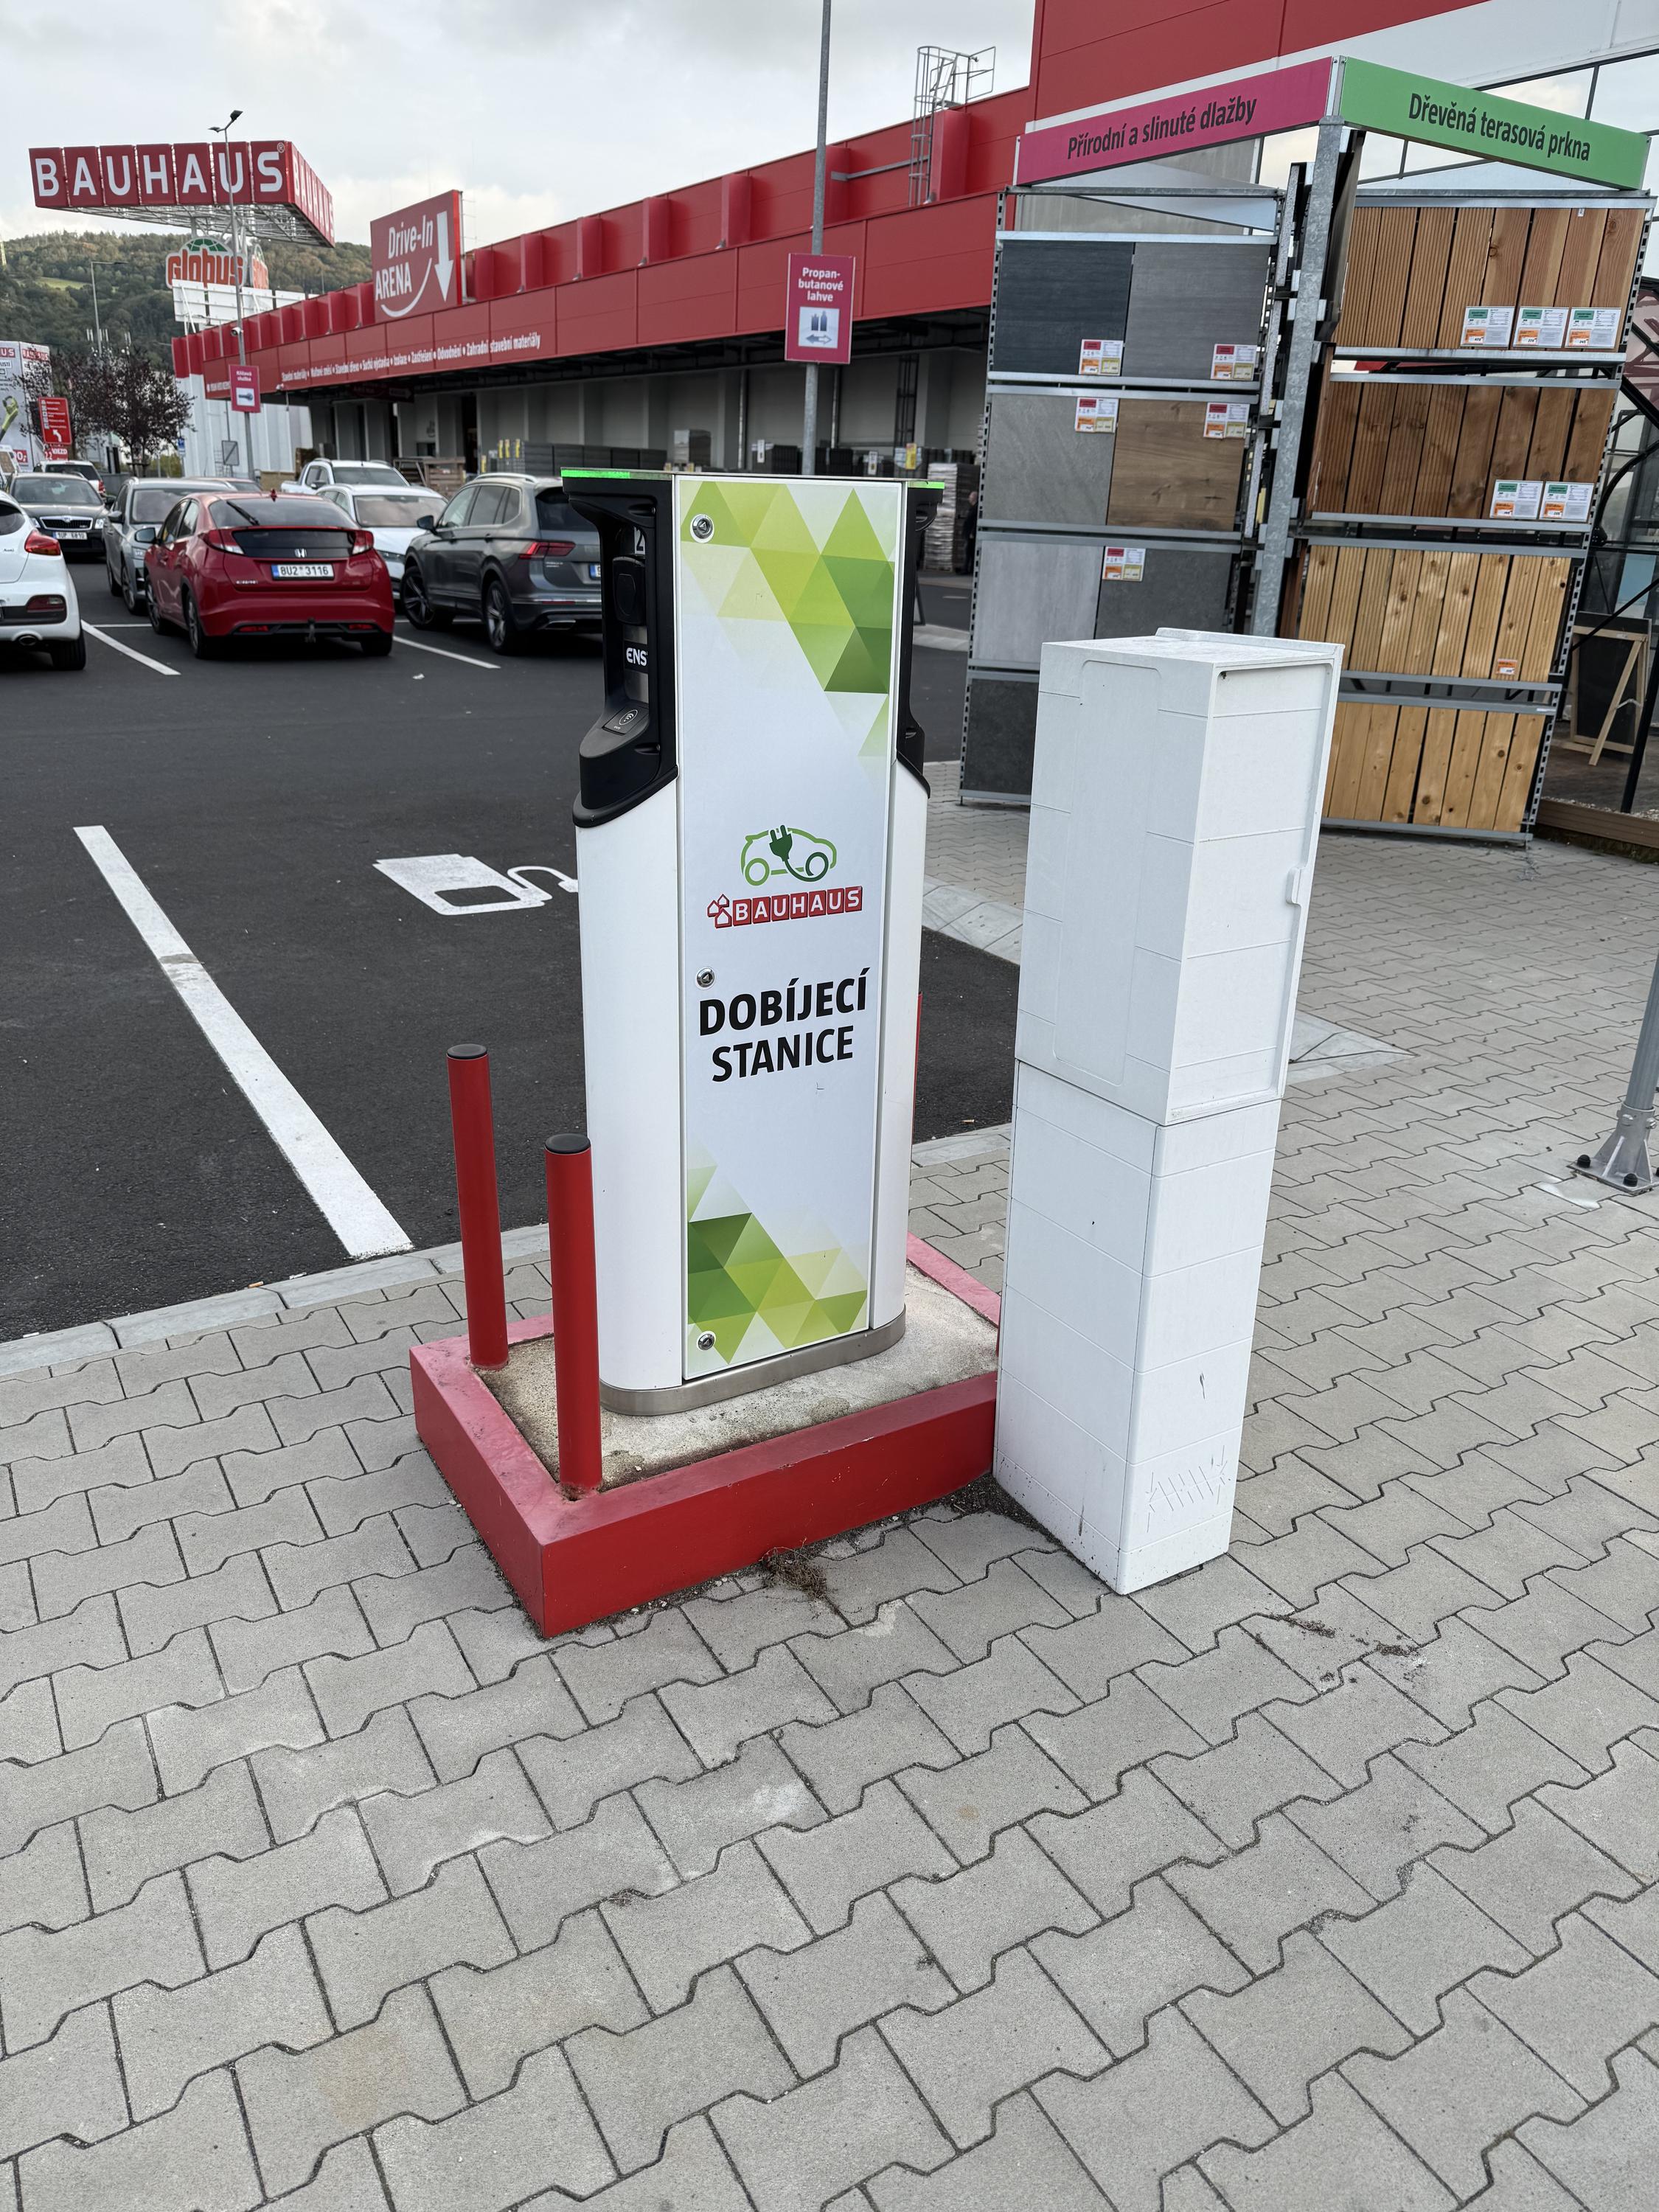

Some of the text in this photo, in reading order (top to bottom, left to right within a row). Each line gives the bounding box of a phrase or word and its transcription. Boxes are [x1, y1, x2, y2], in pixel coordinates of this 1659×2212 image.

[1068, 95, 1257, 160] Přírodní a slinuté dlažby
[1408, 92, 1591, 161] Dřevěná terasová prkna
[388, 215, 434, 259] Drive-In
[375, 262, 412, 301] ARENA
[798, 278, 844, 291] butanové
[801, 267, 841, 280] Propan-
[807, 290, 834, 302] lahve
[280, 566, 329, 576] 8U2 3116
[736, 888, 861, 921] BAUHAUS
[699, 967, 871, 1036] DOBÍJECÍ
[712, 1025, 854, 1083] STANICE
